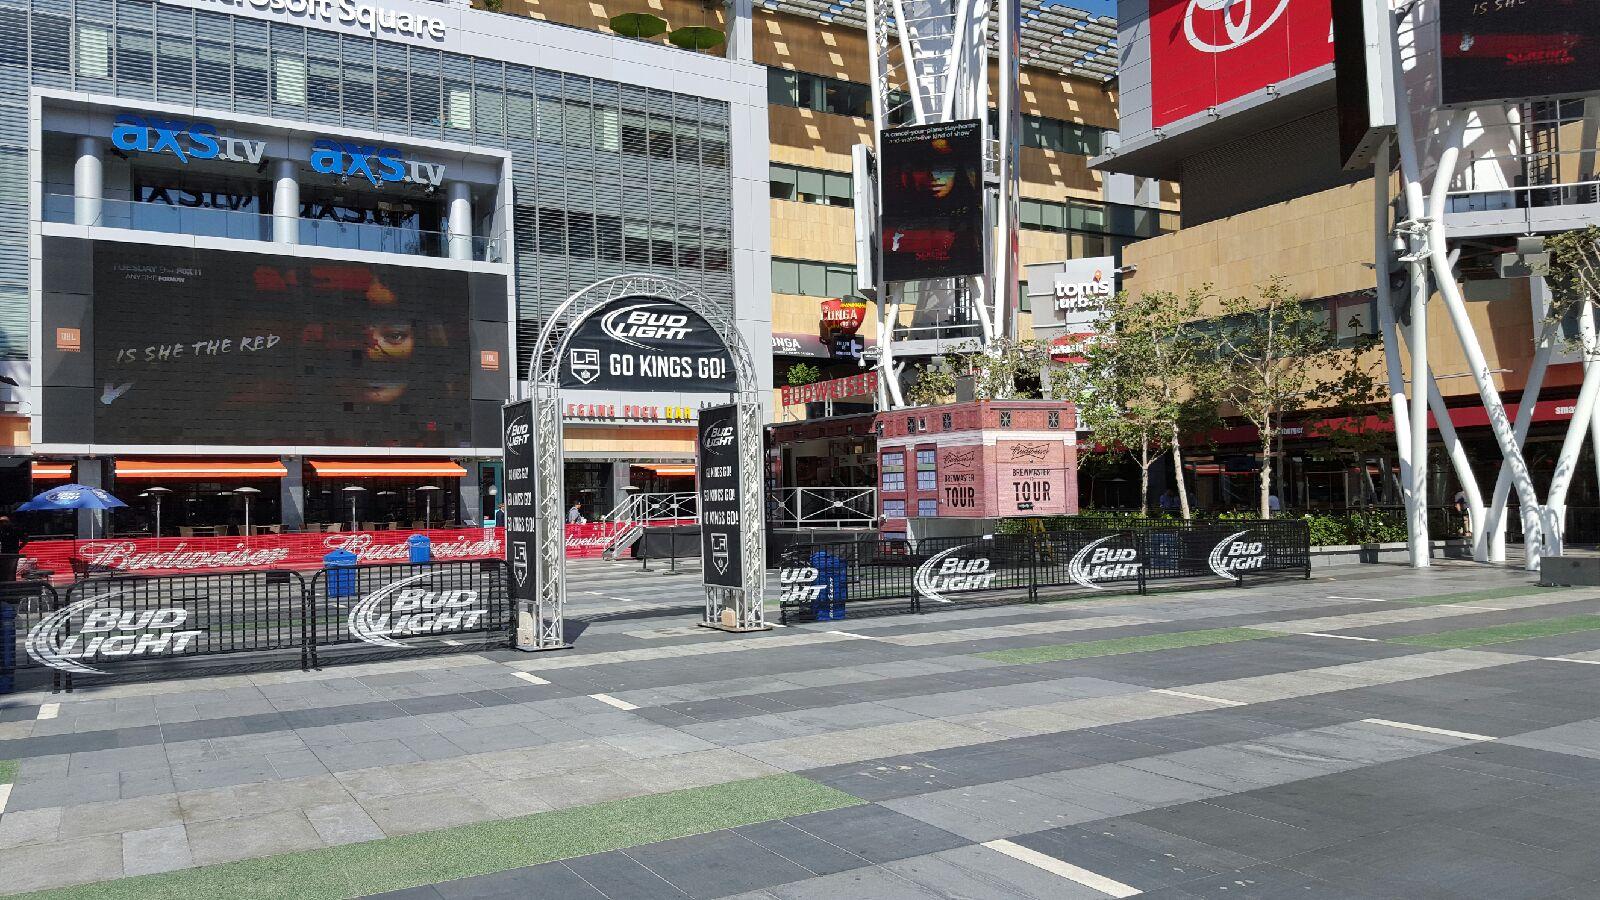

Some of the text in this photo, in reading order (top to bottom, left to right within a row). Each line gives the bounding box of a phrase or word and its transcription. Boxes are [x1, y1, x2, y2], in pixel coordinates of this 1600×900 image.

[1473, 2, 1487, 14] IS
[338, 0, 446, 38] Square
[111, 114, 267, 164] axs.tv
[311, 139, 446, 187] axs.tv
[627, 310, 688, 327] BUD
[613, 321, 693, 340] LIGHT
[116, 333, 282, 363] IS SHE THE RED
[772, 337, 801, 349] ONGA
[610, 354, 726, 379] GO KINGS GO!
[781, 371, 878, 406] BUDWEISER
[511, 423, 529, 436] BUD
[711, 426, 733, 438] BUD
[509, 434, 530, 447] LIGHT
[706, 436, 734, 448] LIGHT
[1012, 468, 1051, 477] BREWMASTER
[944, 486, 975, 507] TOUR
[1012, 481, 1051, 501] TOUR
[79, 542, 290, 570] Budweiser
[323, 533, 501, 560] Budeiser
[1090, 547, 1137, 563] BUD
[1229, 541, 1263, 555] BUD
[938, 557, 990, 575] BUD
[1080, 562, 1143, 579] LIGHT
[1221, 555, 1267, 571] LIGHT
[780, 567, 819, 583] UD
[926, 572, 997, 593] LIGHT
[391, 588, 478, 612] BUD
[780, 584, 828, 602] GHT
[79, 607, 188, 634] BUD
[364, 609, 489, 637] LIGHT
[52, 630, 203, 658] LIGHT
